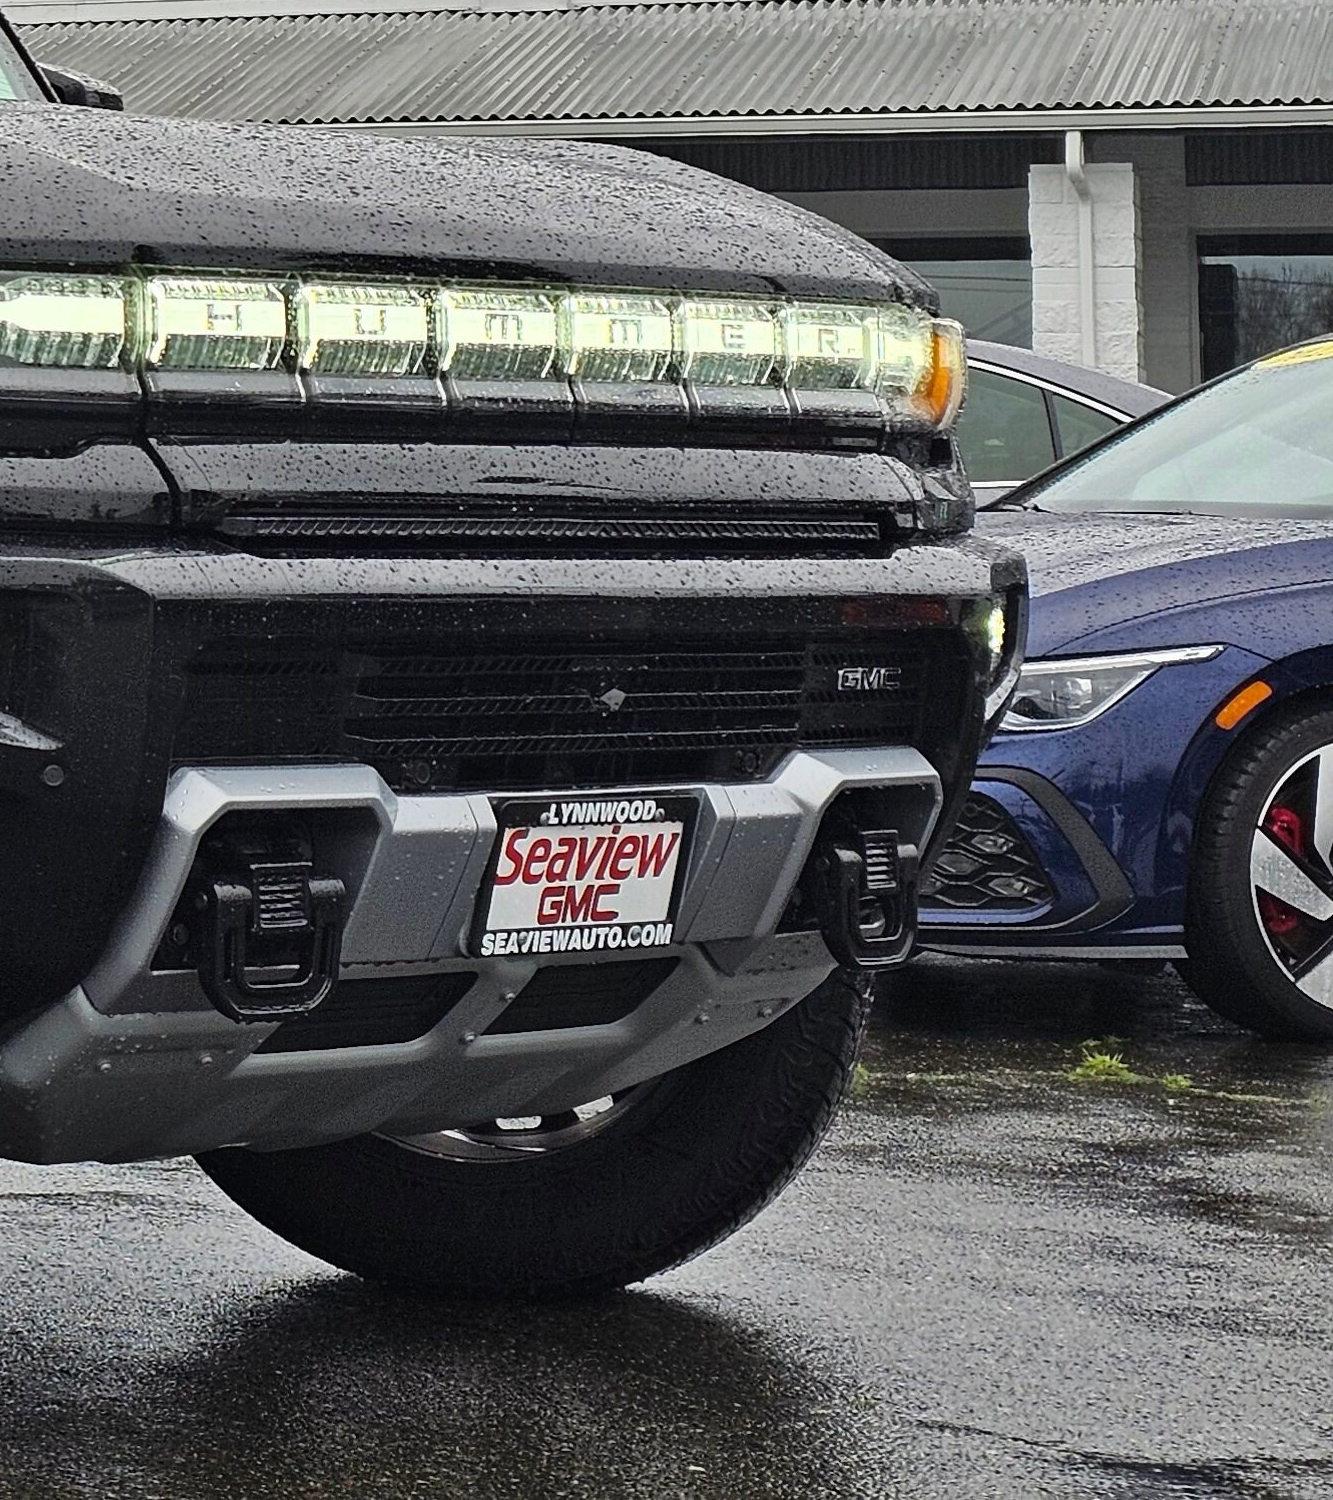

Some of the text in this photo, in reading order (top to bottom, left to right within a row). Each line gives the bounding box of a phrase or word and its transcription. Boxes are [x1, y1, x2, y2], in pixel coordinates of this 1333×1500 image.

[838, 667, 901, 690] GMC
[548, 801, 657, 825] LYNNWOOD
[494, 826, 680, 885] Seaview
[537, 884, 620, 925] GMC
[481, 924, 673, 956] SEAVIEWAUTO.COM
